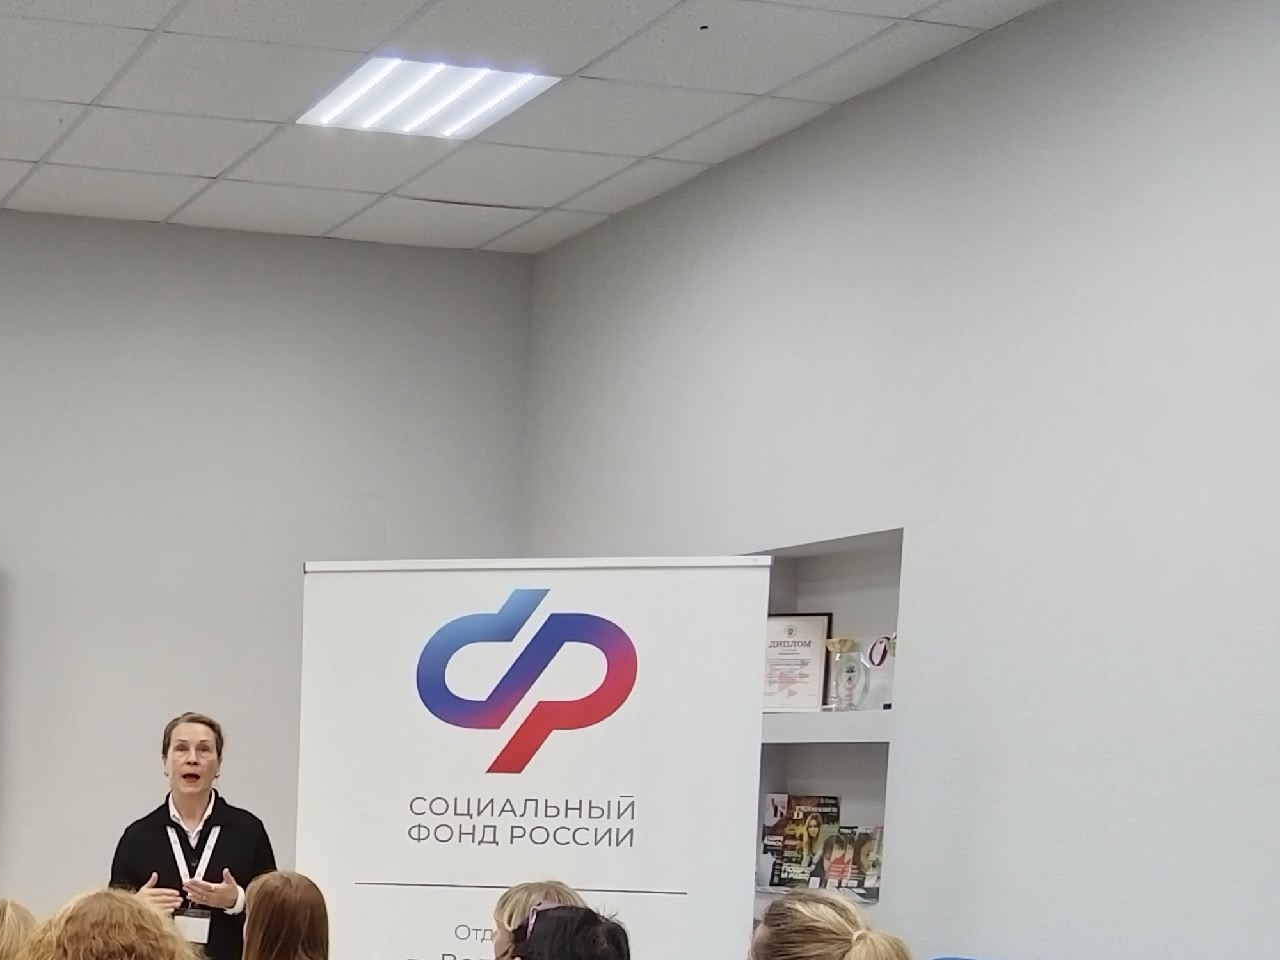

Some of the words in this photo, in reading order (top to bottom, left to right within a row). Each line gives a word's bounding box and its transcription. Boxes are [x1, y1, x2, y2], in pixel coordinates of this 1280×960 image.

[768, 640, 812, 649] ДИПЛОМ
[409, 795, 636, 821] СОЦИАЛЬНЫЙ
[407, 823, 500, 847] ФОНД
[509, 825, 635, 848] РОССИИ
